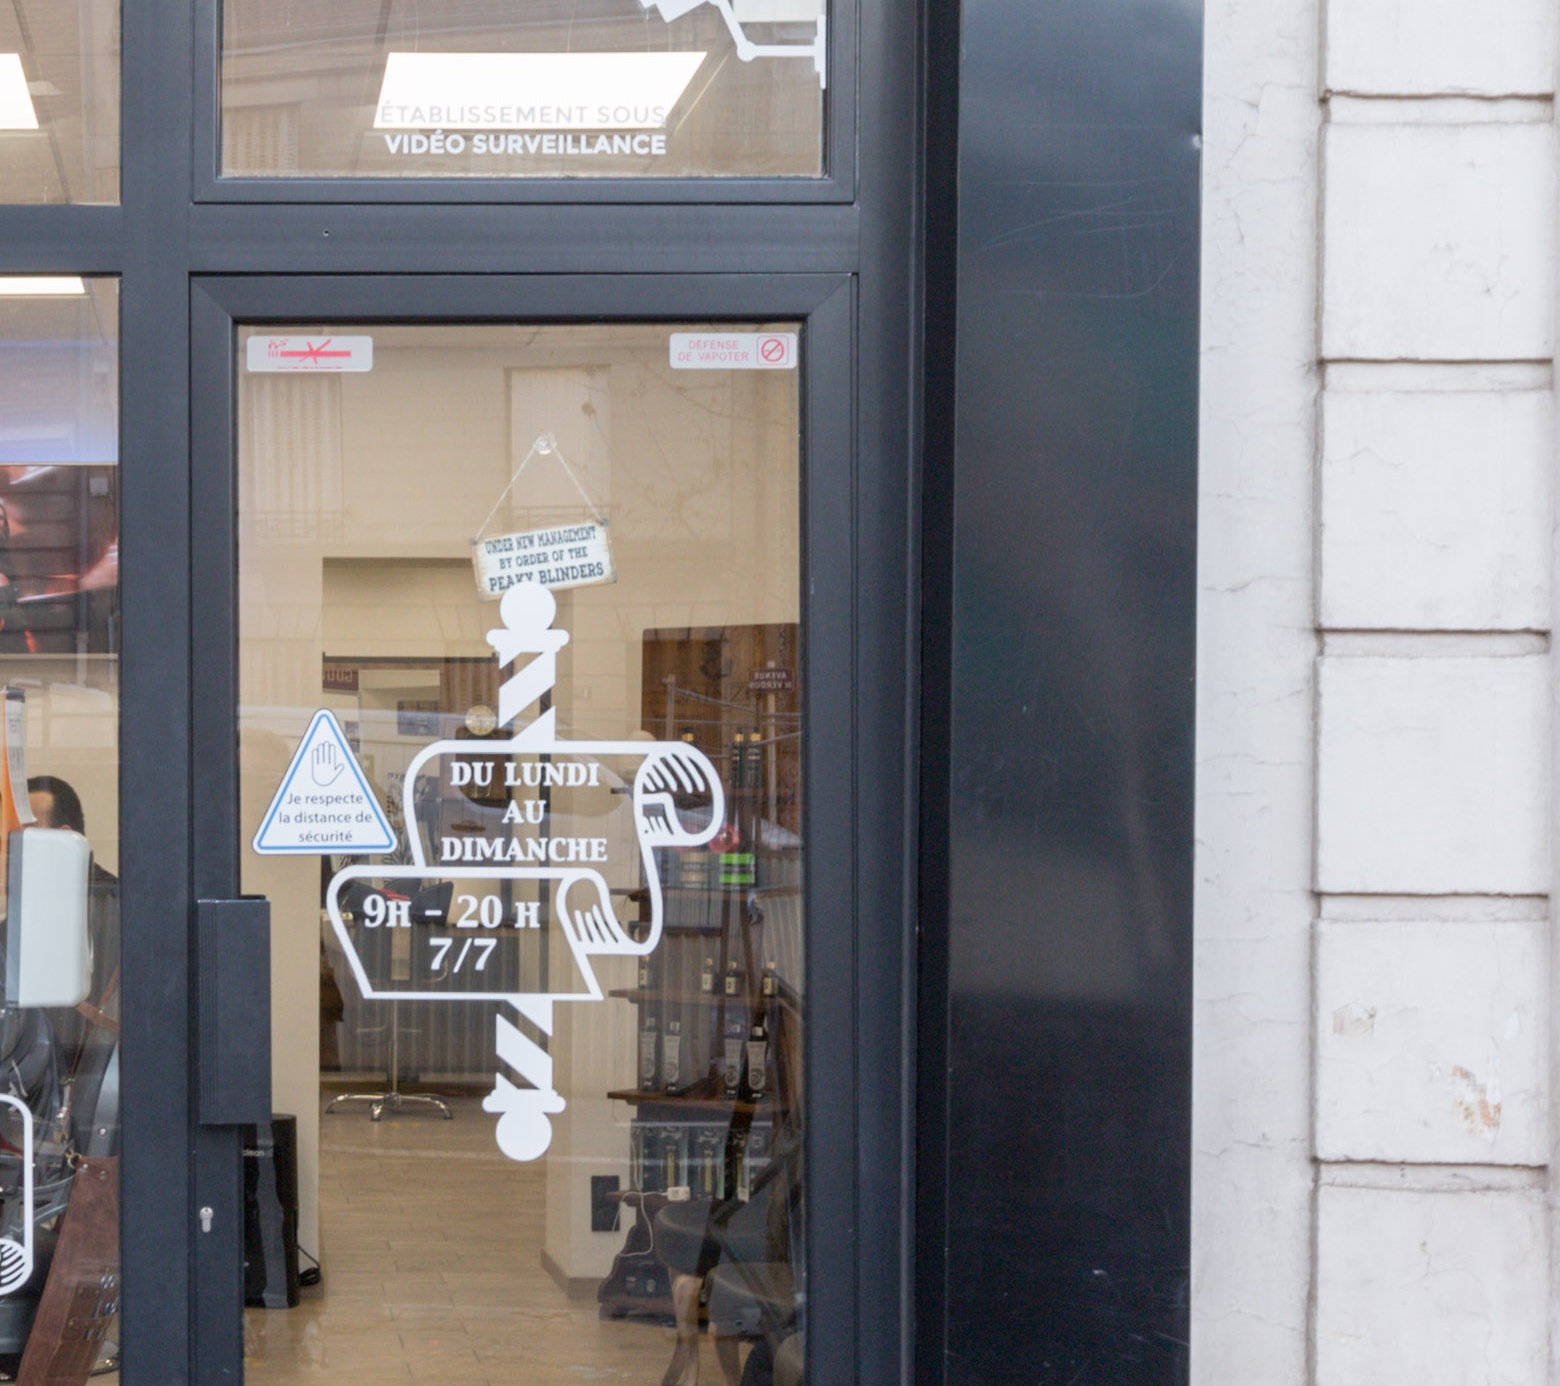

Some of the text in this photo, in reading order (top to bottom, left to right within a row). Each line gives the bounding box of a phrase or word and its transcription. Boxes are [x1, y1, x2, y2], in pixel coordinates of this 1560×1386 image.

[380, 100, 666, 124] ÉTABLISSEMENT SOUS
[384, 128, 667, 155] VIDÉO SURVEILLANCE
[678, 352, 750, 361] DE VAPOTER
[485, 526, 597, 554] UNDER NEW MANAGEMENT
[499, 546, 588, 570] BY ORDER OF THE
[538, 562, 604, 585] BLINDERS
[450, 761, 601, 787] DU LUNDI
[287, 793, 363, 807] Je respecte
[502, 799, 546, 825] AU
[279, 811, 372, 823] la distance de
[299, 829, 353, 842] sécurité
[441, 836, 608, 862] DIMANCHE
[363, 894, 412, 928] 9H
[456, 894, 503, 928] 20
[515, 902, 540, 928] H
[429, 938, 497, 973] 7/7
